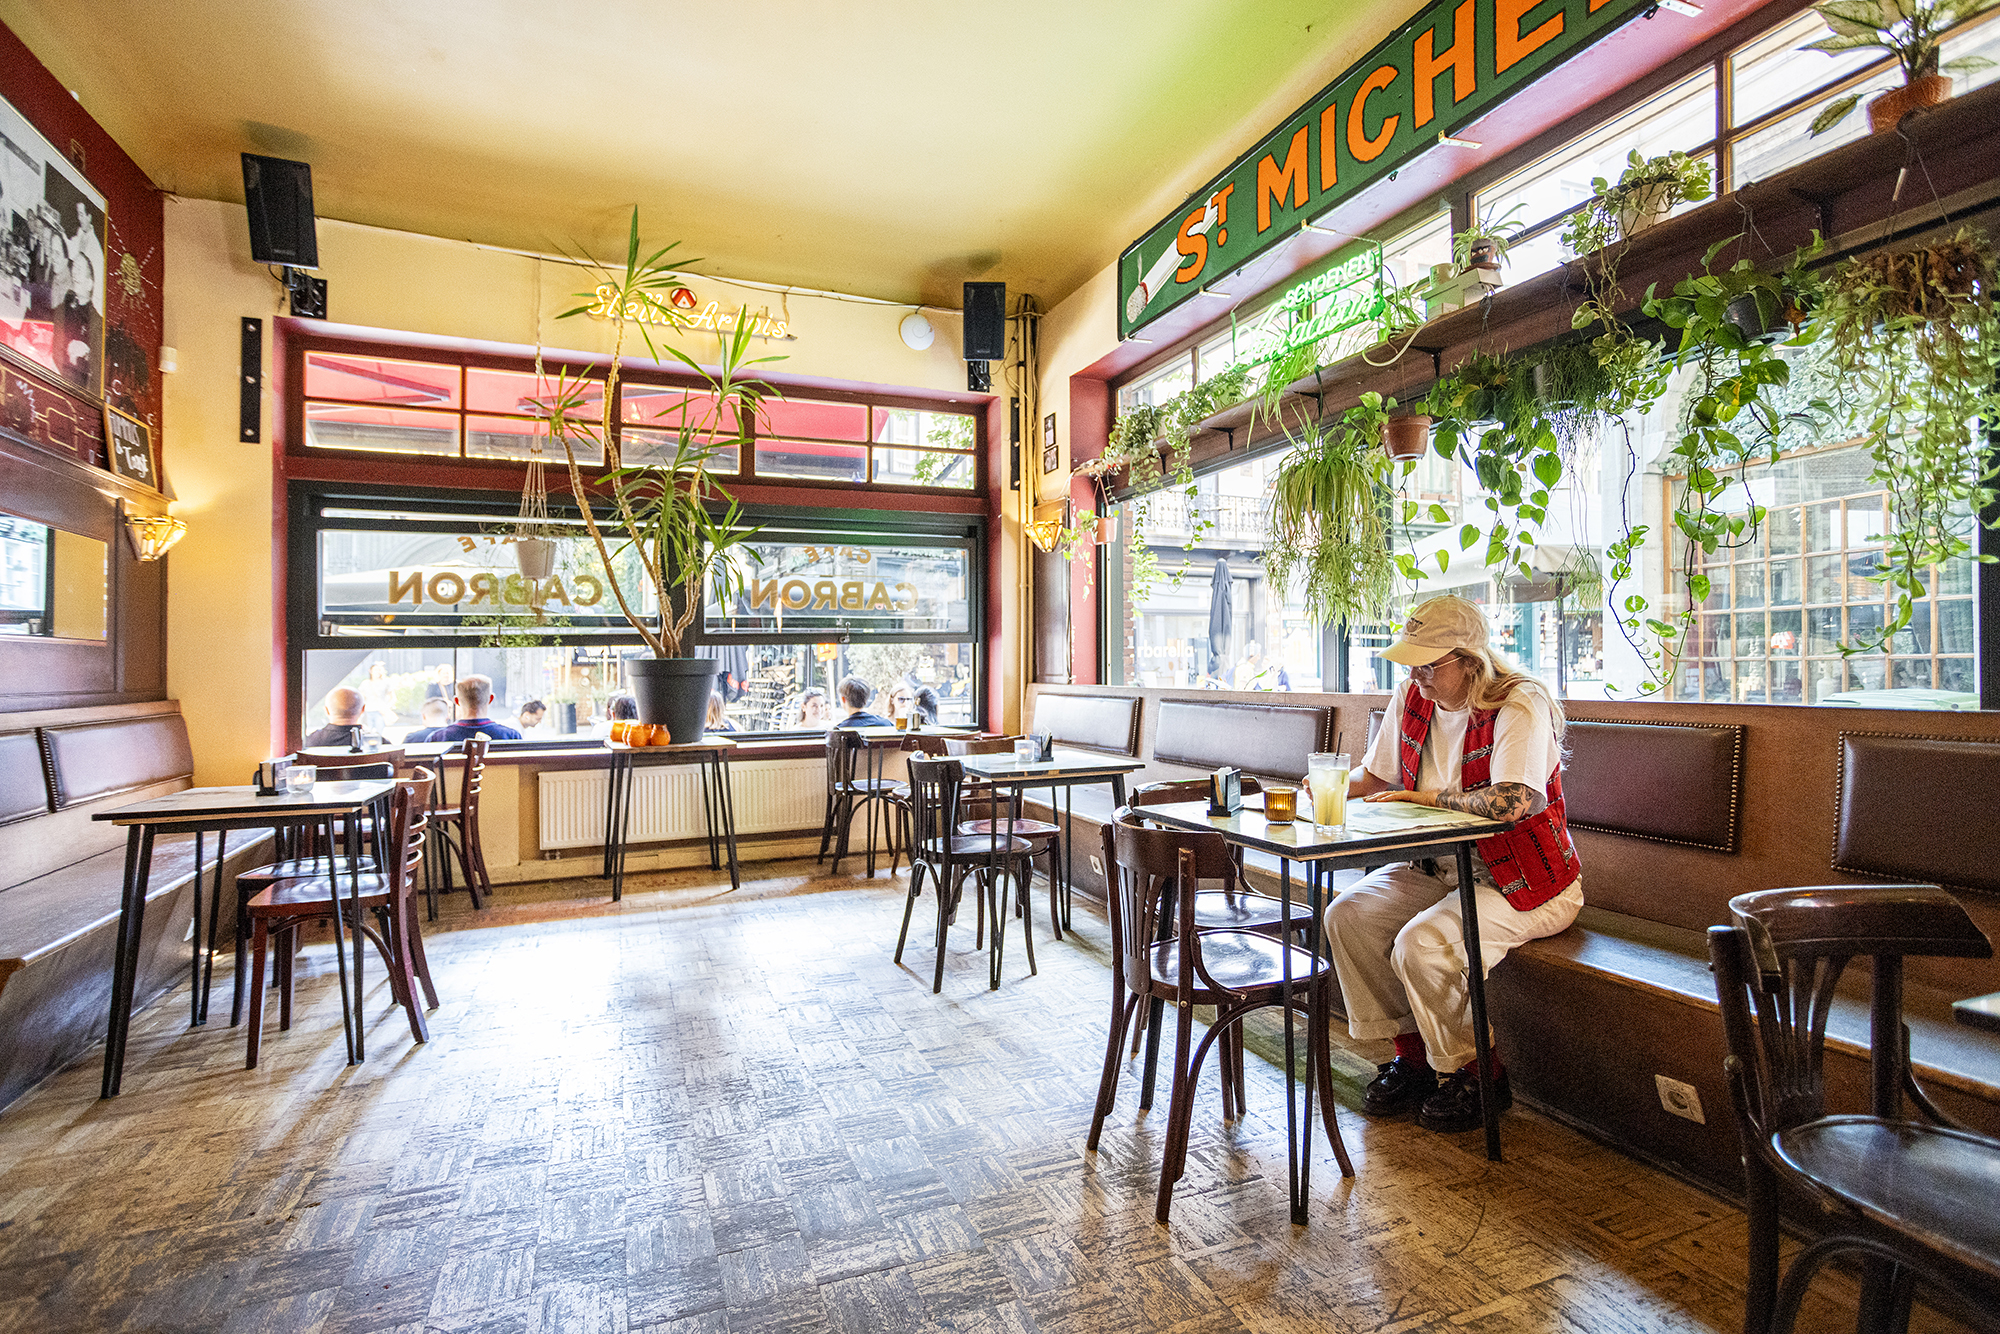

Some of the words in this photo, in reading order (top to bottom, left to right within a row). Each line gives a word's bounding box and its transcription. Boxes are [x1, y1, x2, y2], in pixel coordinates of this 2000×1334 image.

[1256, 0, 1614, 237] MICHE
[587, 285, 681, 327] Stella
[1284, 248, 1376, 308] SCHOENEN
